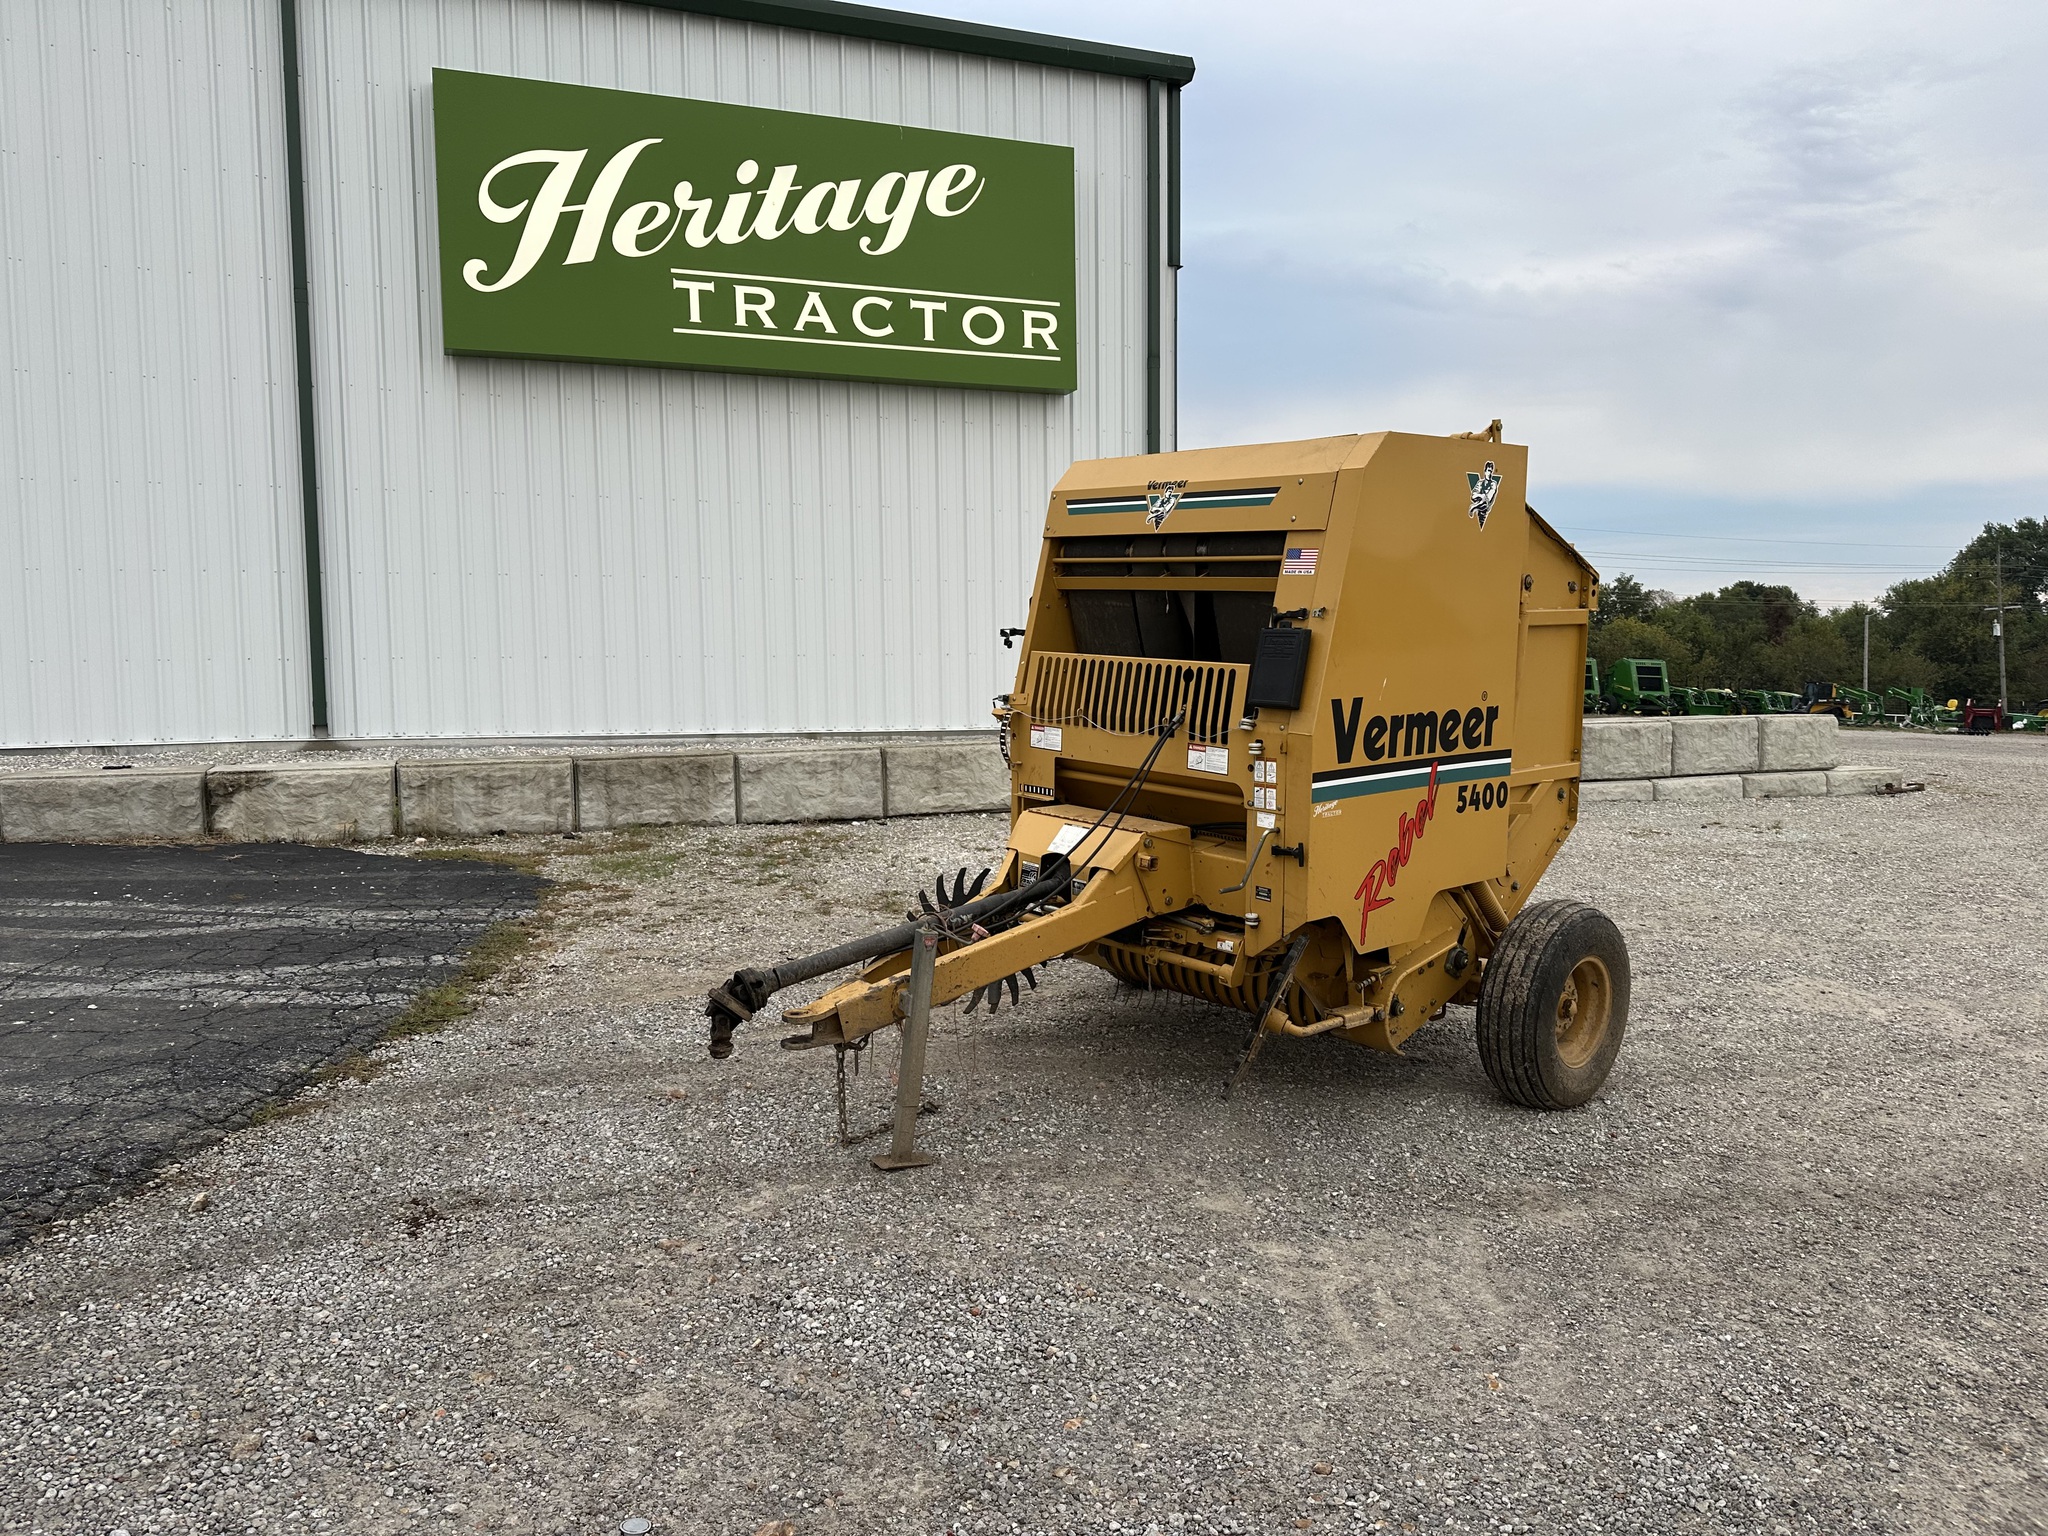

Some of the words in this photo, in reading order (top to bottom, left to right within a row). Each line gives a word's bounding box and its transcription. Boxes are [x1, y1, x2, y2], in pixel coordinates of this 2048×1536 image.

[462, 137, 985, 294] Heritage
[671, 277, 1060, 352] TRACTOR
[1147, 480, 1189, 491] Vermeer
[1331, 697, 1499, 764] Vermeer
[1456, 780, 1509, 814] 5400
[1354, 760, 1440, 947] Rebel
